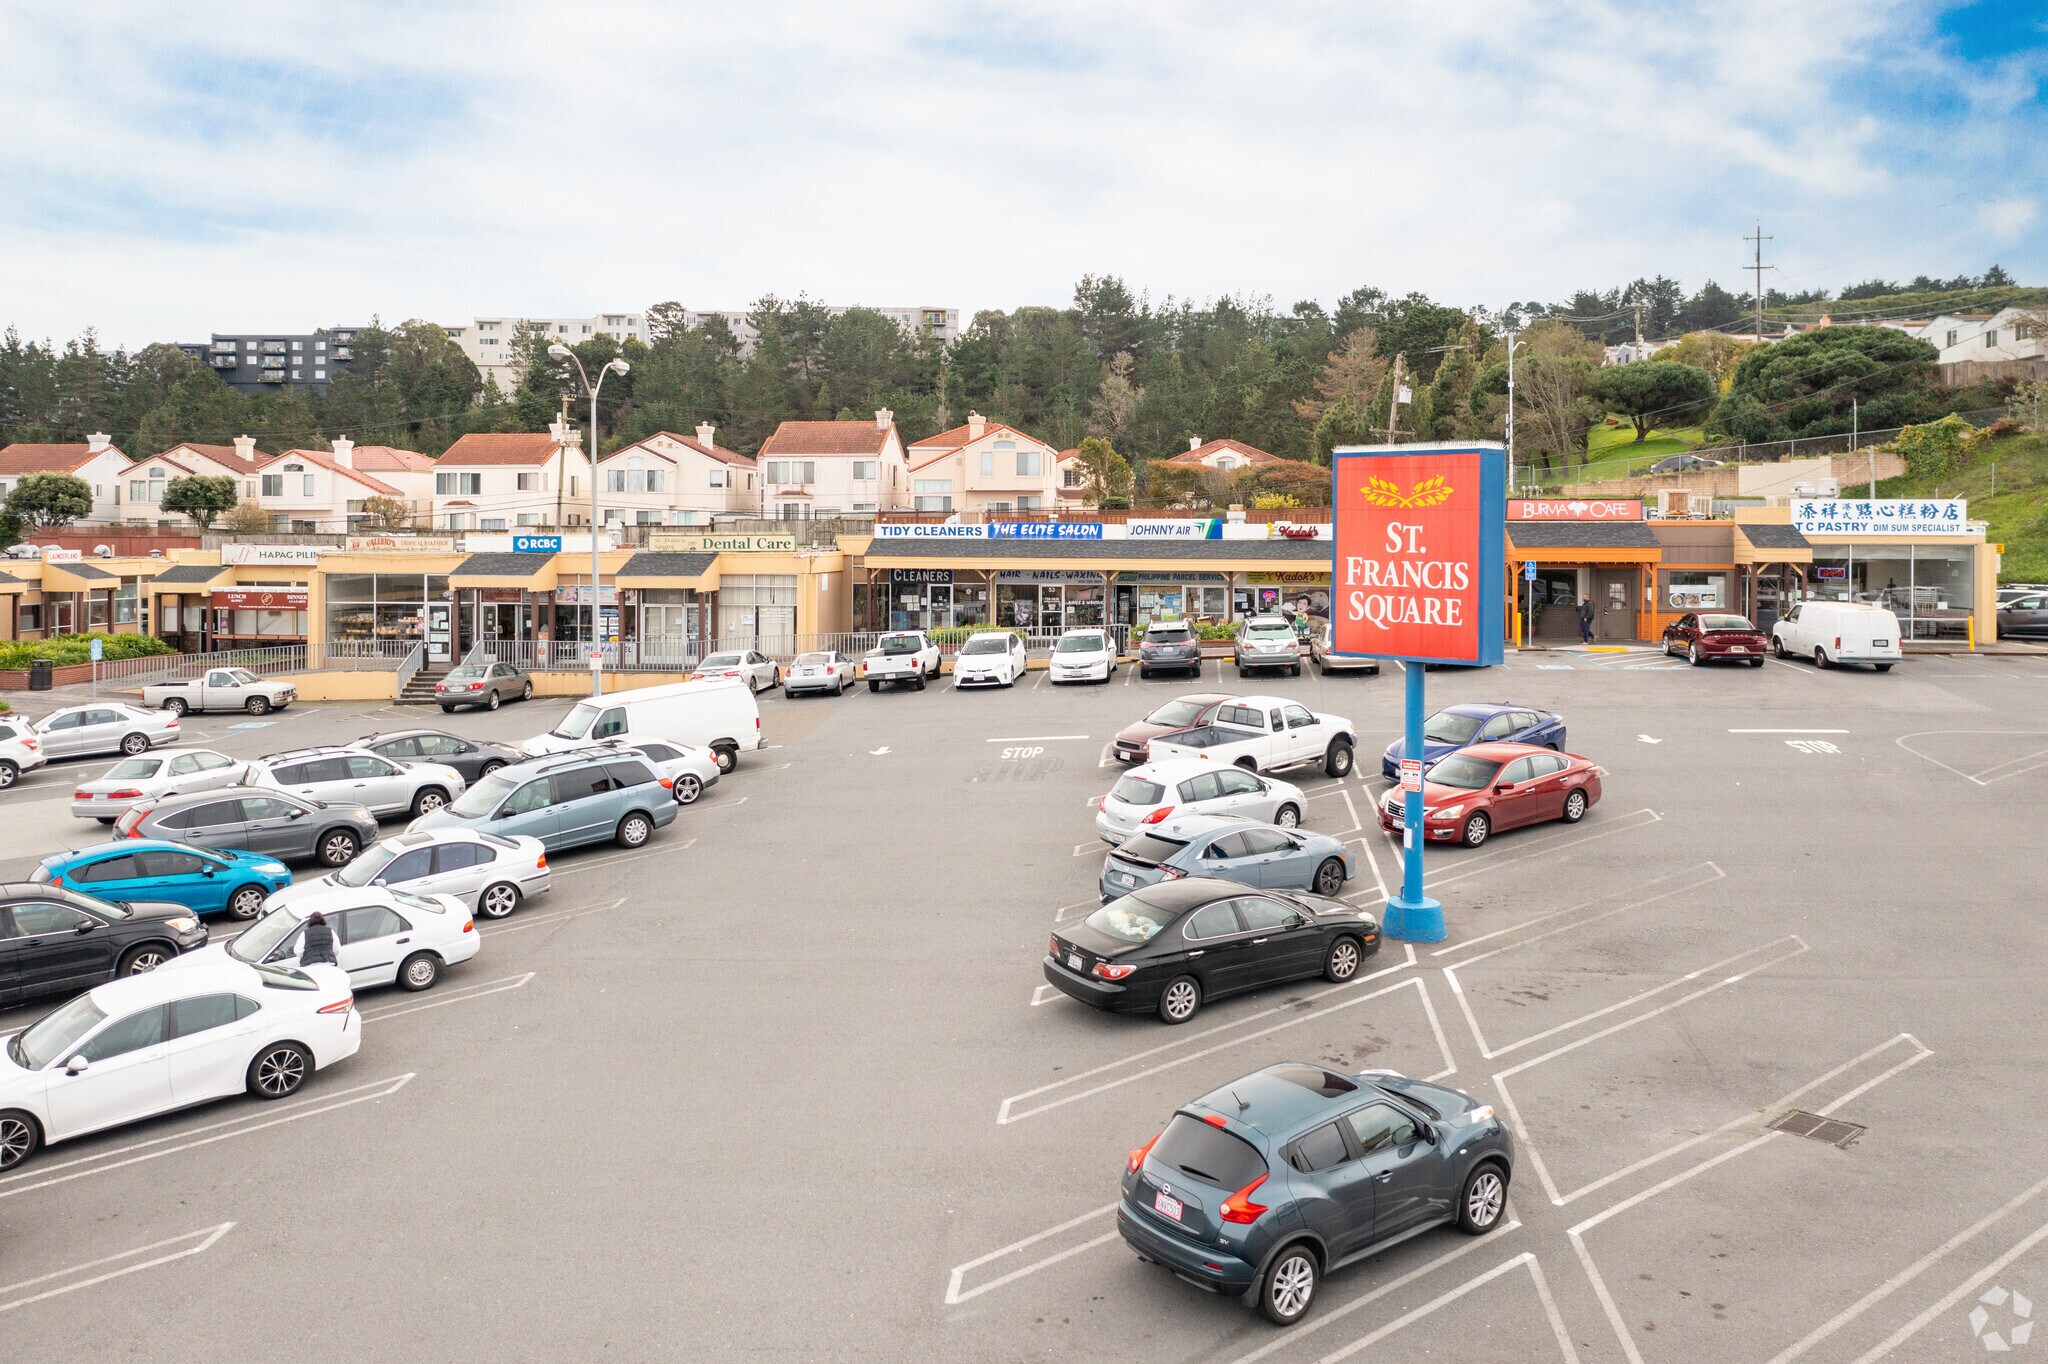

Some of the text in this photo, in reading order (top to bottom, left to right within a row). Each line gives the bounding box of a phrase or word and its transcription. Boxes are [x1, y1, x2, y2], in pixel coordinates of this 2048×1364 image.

[1521, 501, 1630, 518] BURMA CAFE
[881, 526, 983, 536] TIDY CLEANERS
[993, 524, 1100, 536] THE ELITE SALON
[1130, 525, 1191, 535] JOHNNY AIR
[1278, 525, 1319, 537] Kadok's
[1806, 522, 1815, 532] C
[1818, 522, 1869, 532] PASTRY
[1873, 524, 1889, 532] DIM
[1891, 524, 1910, 532] SUM
[1911, 524, 1961, 532] SPECIALIST
[366, 538, 396, 547] VALERIO'S
[702, 537, 791, 550] Dental Care
[1385, 521, 1427, 554] ST.
[530, 539, 558, 549] RCBC
[259, 551, 294, 559] HAPAG
[893, 569, 949, 582] CLEANERS
[1000, 570, 1022, 578] HAIR
[1138, 573, 1170, 581] PHILIPPINE
[1173, 573, 1196, 581] PARCEL
[1275, 571, 1315, 582] Kadok's
[1345, 556, 1469, 590] FRANCIS
[1349, 591, 1463, 630] SQUARE
[1001, 746, 1044, 759] STOP
[1784, 740, 1842, 753] STOP
